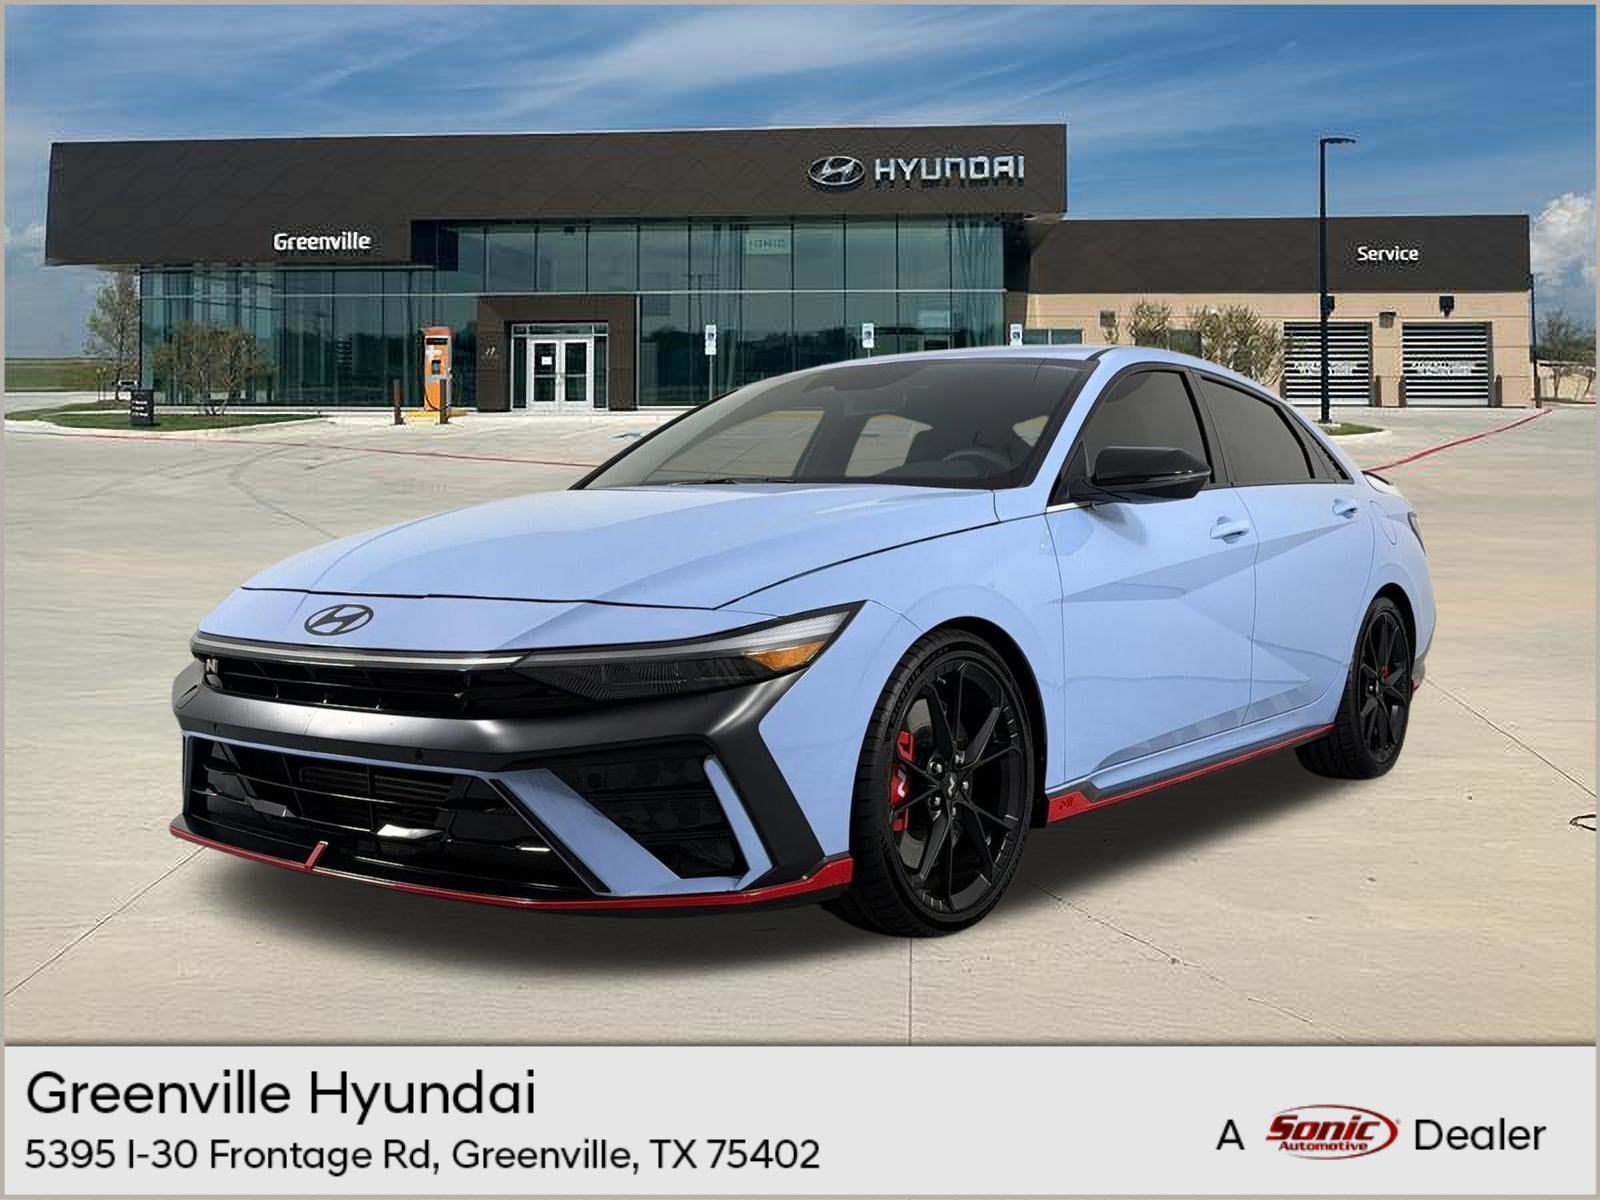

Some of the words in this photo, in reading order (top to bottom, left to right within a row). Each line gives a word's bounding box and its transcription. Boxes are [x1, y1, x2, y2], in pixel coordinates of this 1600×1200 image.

[875, 155, 1025, 181] HYUNDAI
[273, 230, 371, 251] Greenville
[1357, 245, 1419, 261] Service
